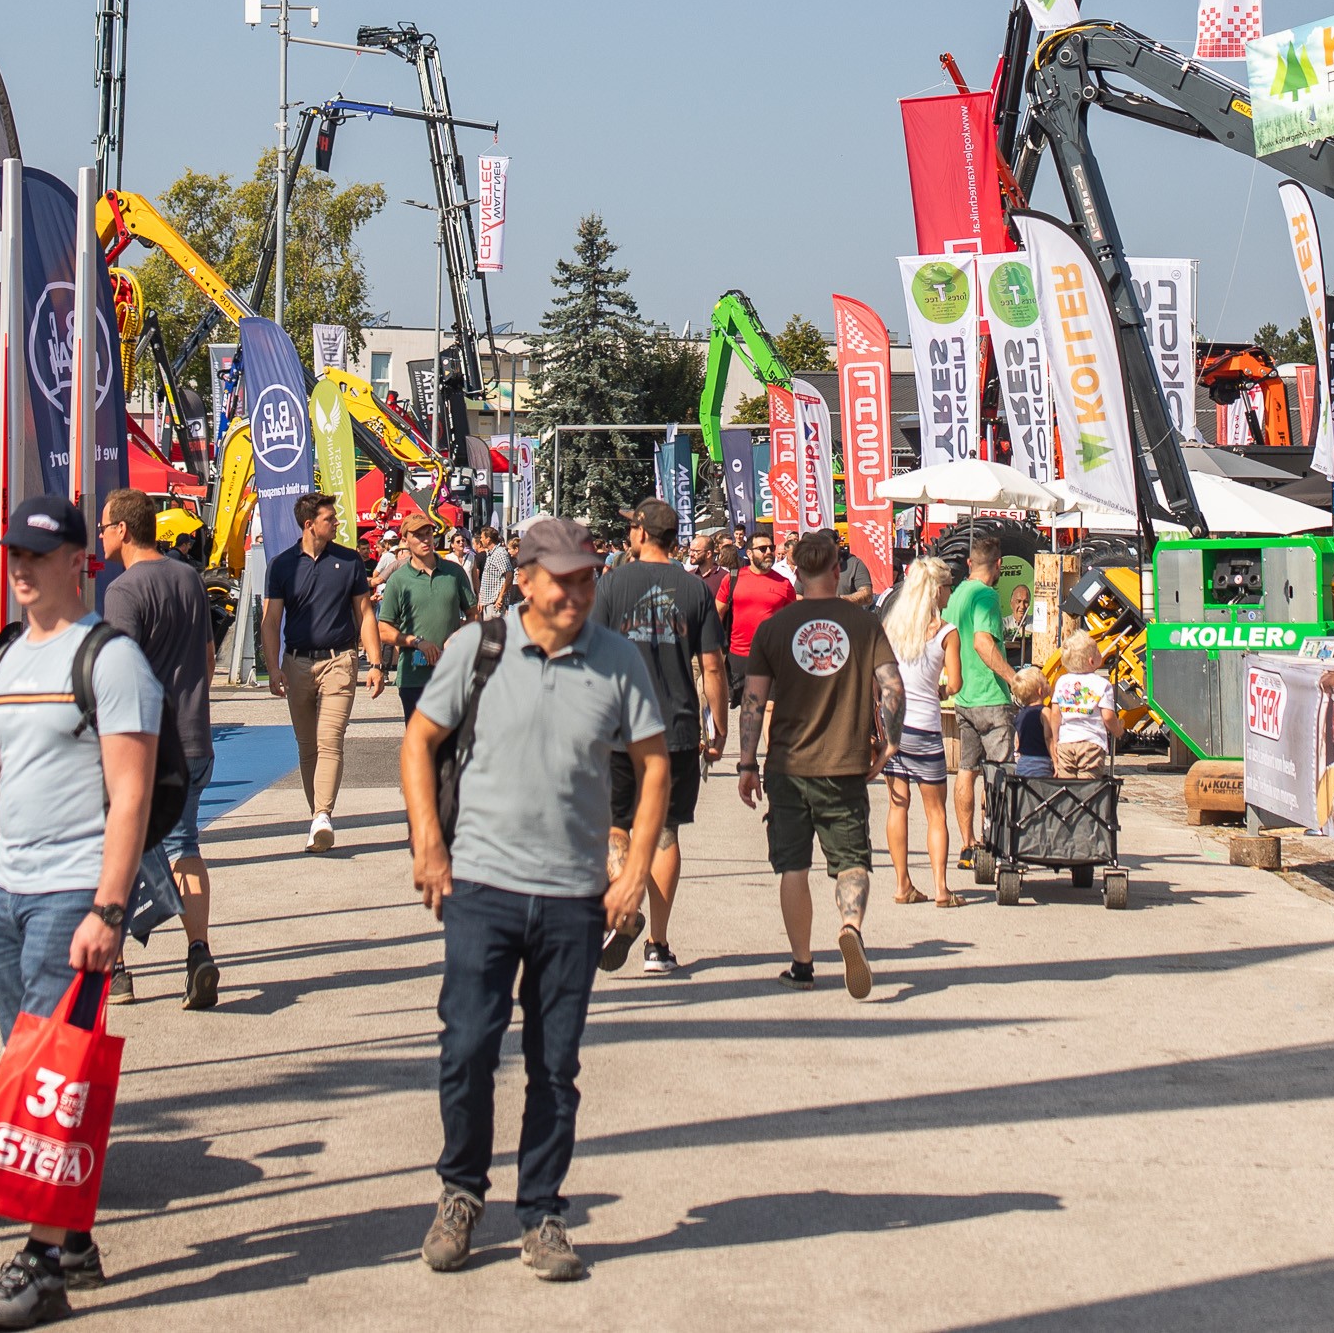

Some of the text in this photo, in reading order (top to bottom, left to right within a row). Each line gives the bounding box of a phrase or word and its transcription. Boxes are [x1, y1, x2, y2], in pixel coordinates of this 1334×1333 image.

[1180, 627, 1283, 647] KOLLER
[1249, 673, 1281, 735] STEPA
[1213, 779, 1244, 791] KOLLE
